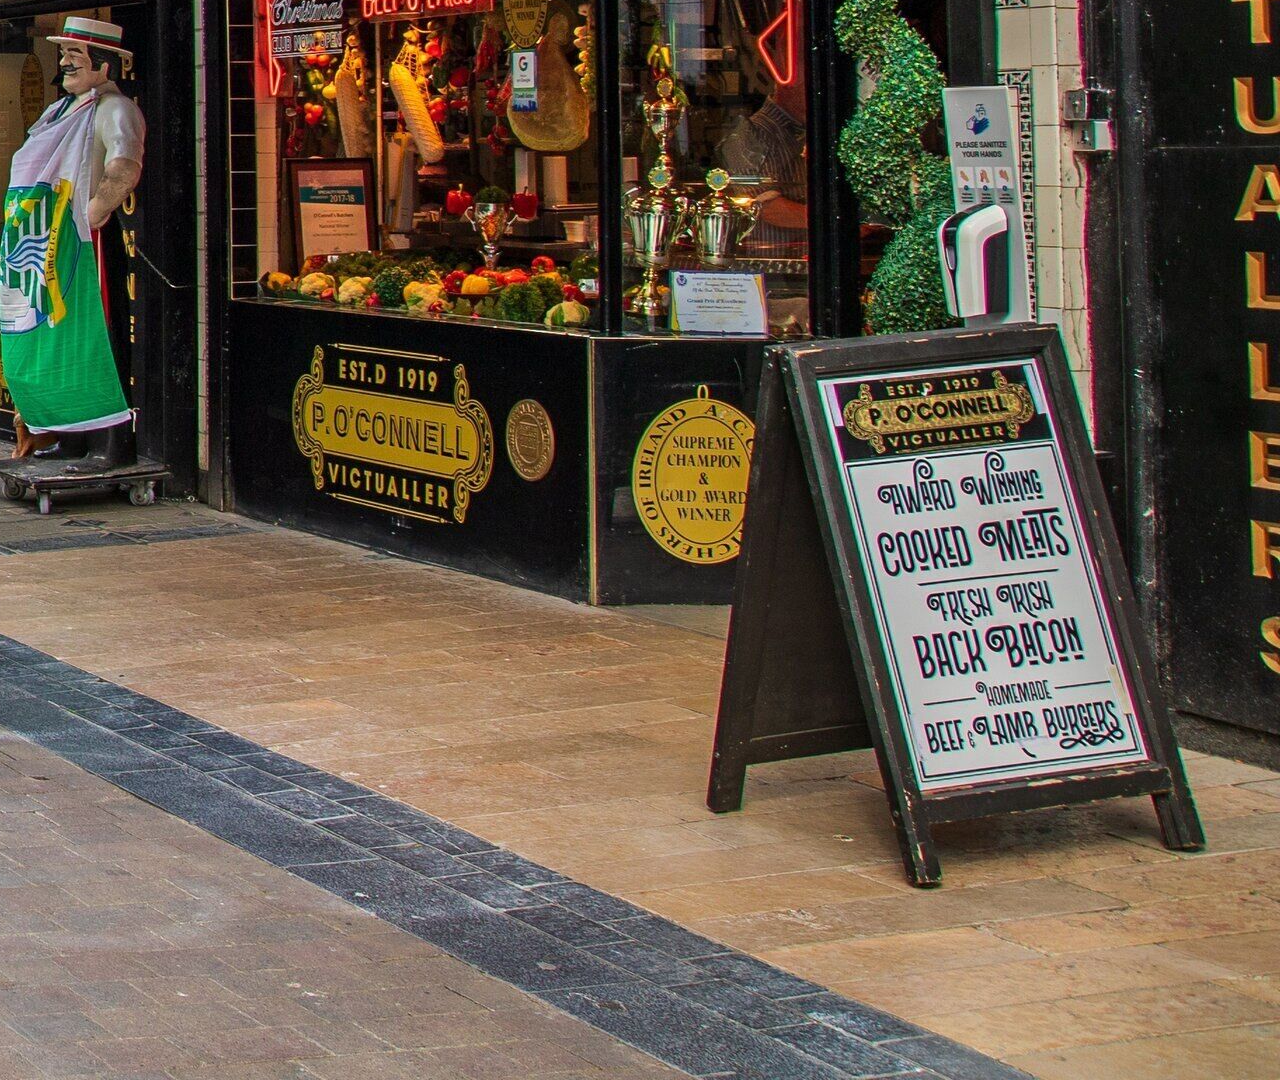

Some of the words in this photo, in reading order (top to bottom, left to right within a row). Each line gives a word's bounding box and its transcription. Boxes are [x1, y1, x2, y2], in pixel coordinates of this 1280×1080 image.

[516, 11, 535, 20] WINNER
[272, 36, 292, 53] CLUB
[293, 34, 315, 51] NOW
[320, 31, 342, 48] OPEN
[979, 140, 1007, 148] SANITIZE
[329, 194, 355, 203] 2017-18
[47, 227, 58, 282] Limerick
[398, 366, 438, 392] 1919
[943, 377, 980, 391] 1919
[895, 394, 1009, 423] O'CONNELL
[332, 404, 471, 461] O'CONNELL
[672, 436, 735, 451] SUPREME
[887, 424, 1005, 448] VICTUALLER
[639, 408, 687, 488] IRELAND
[667, 454, 741, 469] CHAMPION
[328, 462, 449, 509] VICTUALLER
[698, 472, 709, 486] &
[878, 459, 957, 515] AWARD
[961, 451, 1045, 507] WINNING
[642, 497, 659, 520] OF
[660, 490, 696, 503] GOLD
[703, 490, 747, 504] AWARD
[677, 508, 731, 522] WINNER
[879, 523, 973, 578] COOKED
[978, 507, 1071, 562] MEATS
[926, 587, 993, 626] FRESH
[997, 580, 1056, 618] IRISH
[912, 629, 986, 680] BACK
[985, 616, 1086, 670] BACON
[975, 678, 1053, 707] HOMEMADE
[923, 719, 964, 755] BEEF
[973, 710, 1039, 752] LAMB
[1045, 700, 1125, 750] BURGERS
